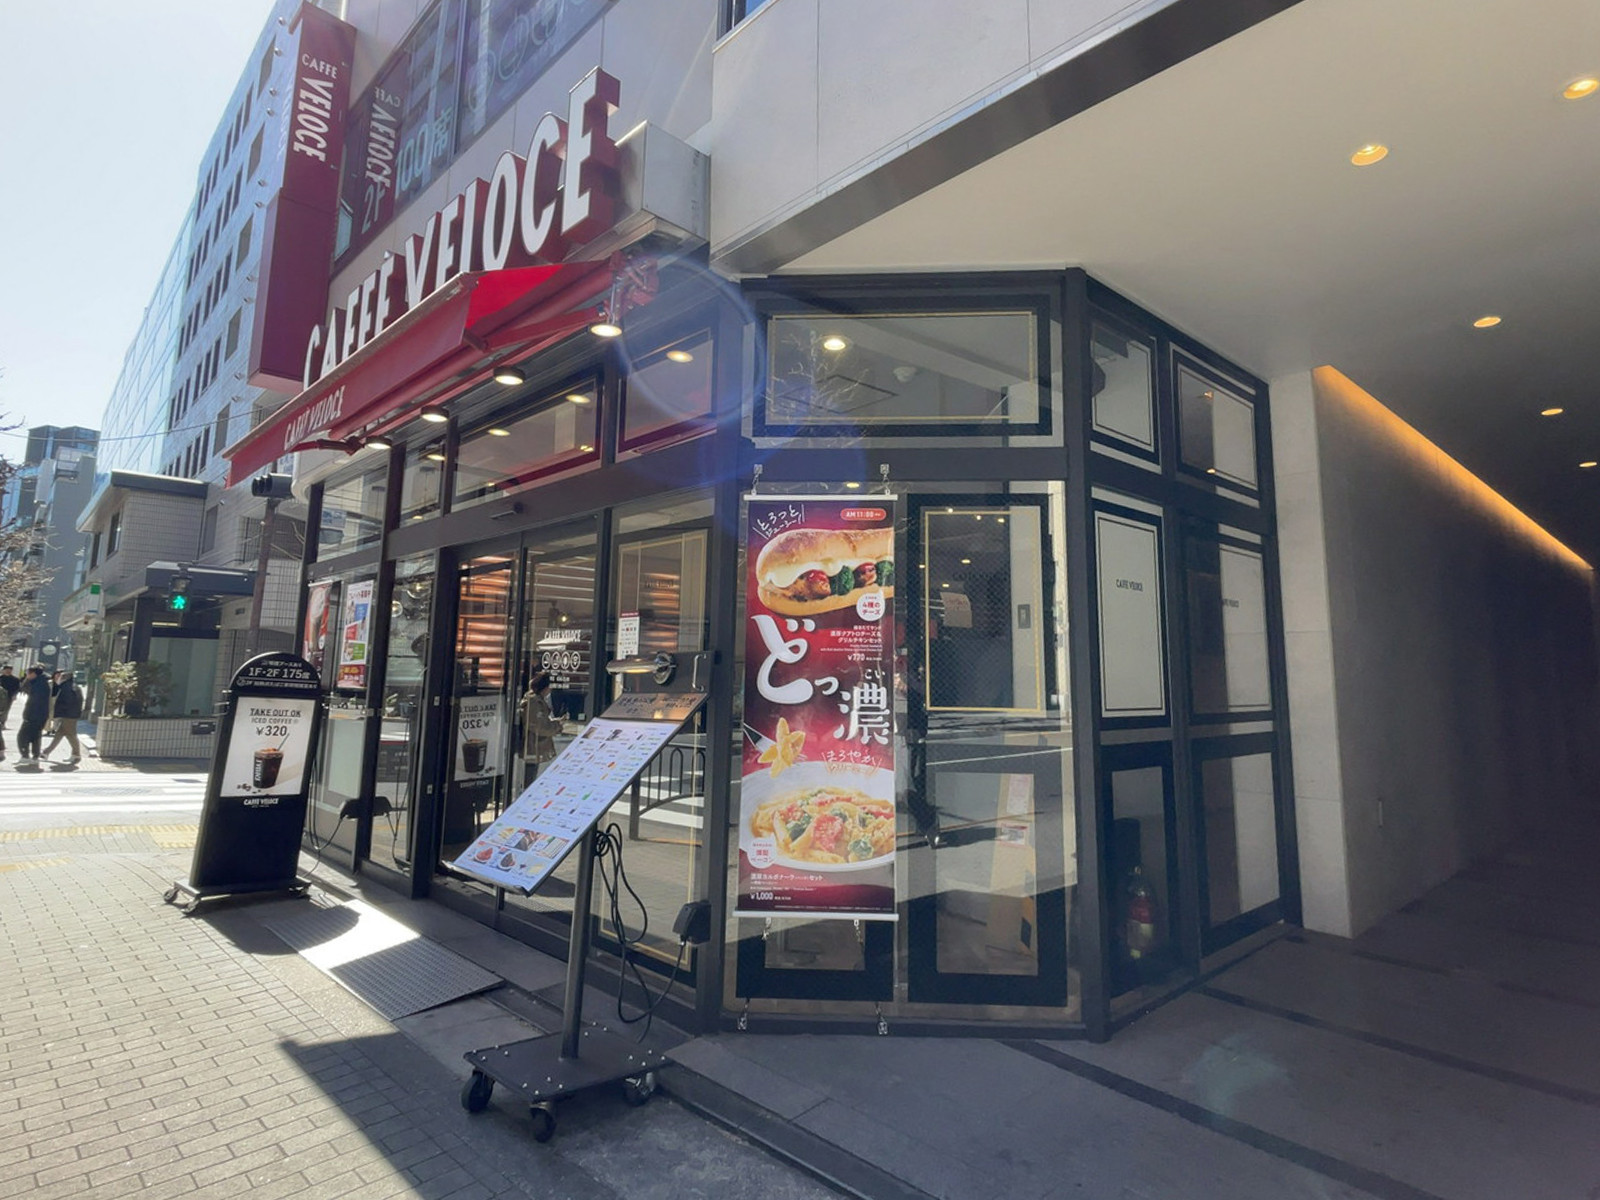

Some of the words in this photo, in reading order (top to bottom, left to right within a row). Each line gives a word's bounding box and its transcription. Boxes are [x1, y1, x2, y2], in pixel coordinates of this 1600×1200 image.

[293, 76, 334, 162] VELOCE
[757, 504, 799, 531] とろっと
[865, 668, 886, 680] こい
[250, 708, 272, 716] TAKE
[273, 708, 289, 717] OUT
[256, 725, 288, 737] ¥320
